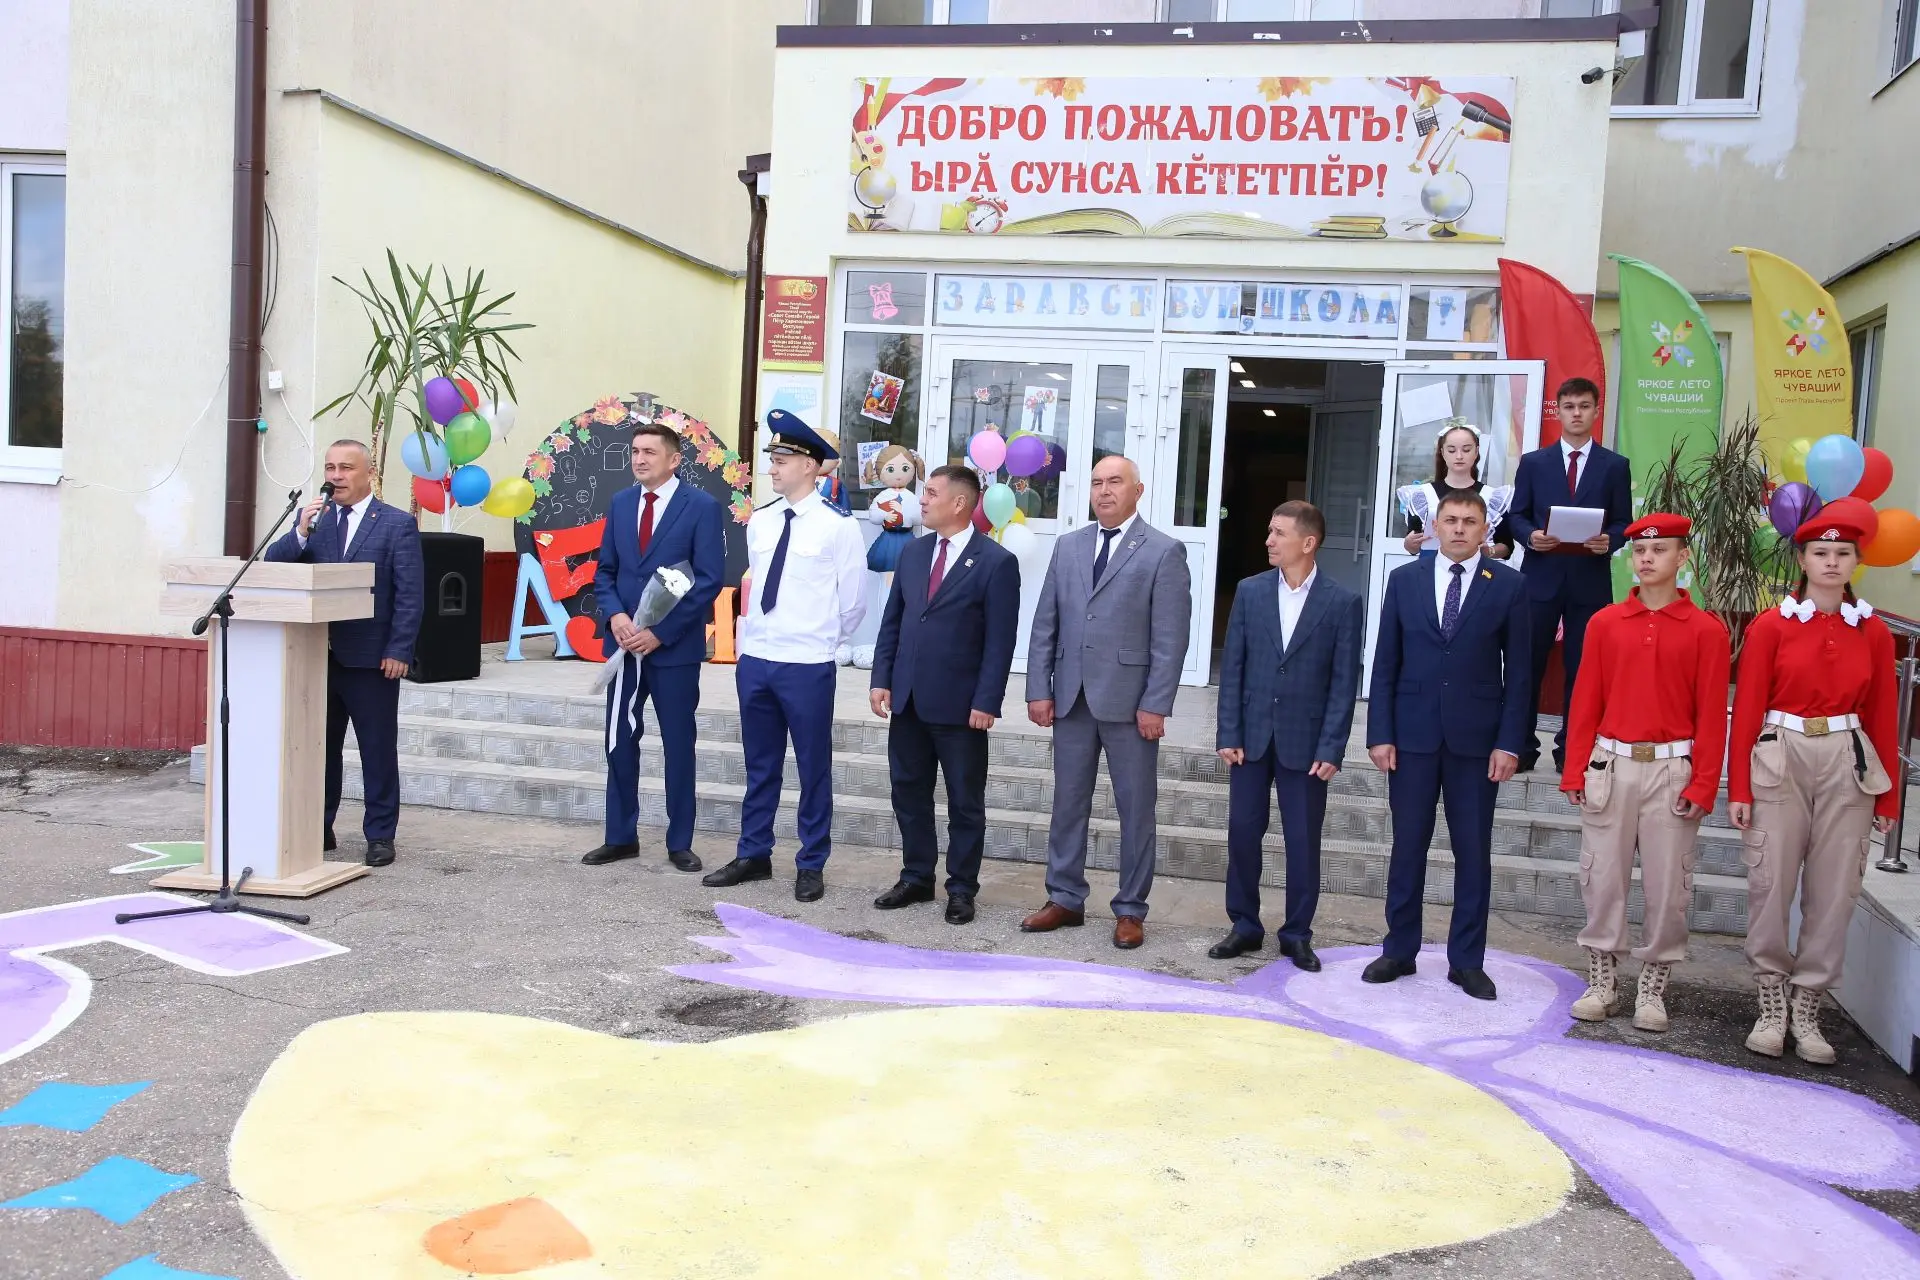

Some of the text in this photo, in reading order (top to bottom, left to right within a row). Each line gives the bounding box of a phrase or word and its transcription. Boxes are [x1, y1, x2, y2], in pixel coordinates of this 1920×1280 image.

[898, 104, 1406, 147] ДОБРО ПОЖАЛОВАТЬ!
[1011, 161, 1141, 194] СУНСА
[1774, 367, 1846, 379] ЯРКОЕ ЛЕТО
[1637, 379, 1711, 389] ЯРКОЕ ЛЕТО
[1783, 382, 1841, 393] ЧУВАШИИ
[1645, 393, 1704, 403] ЧУВАШИИ
